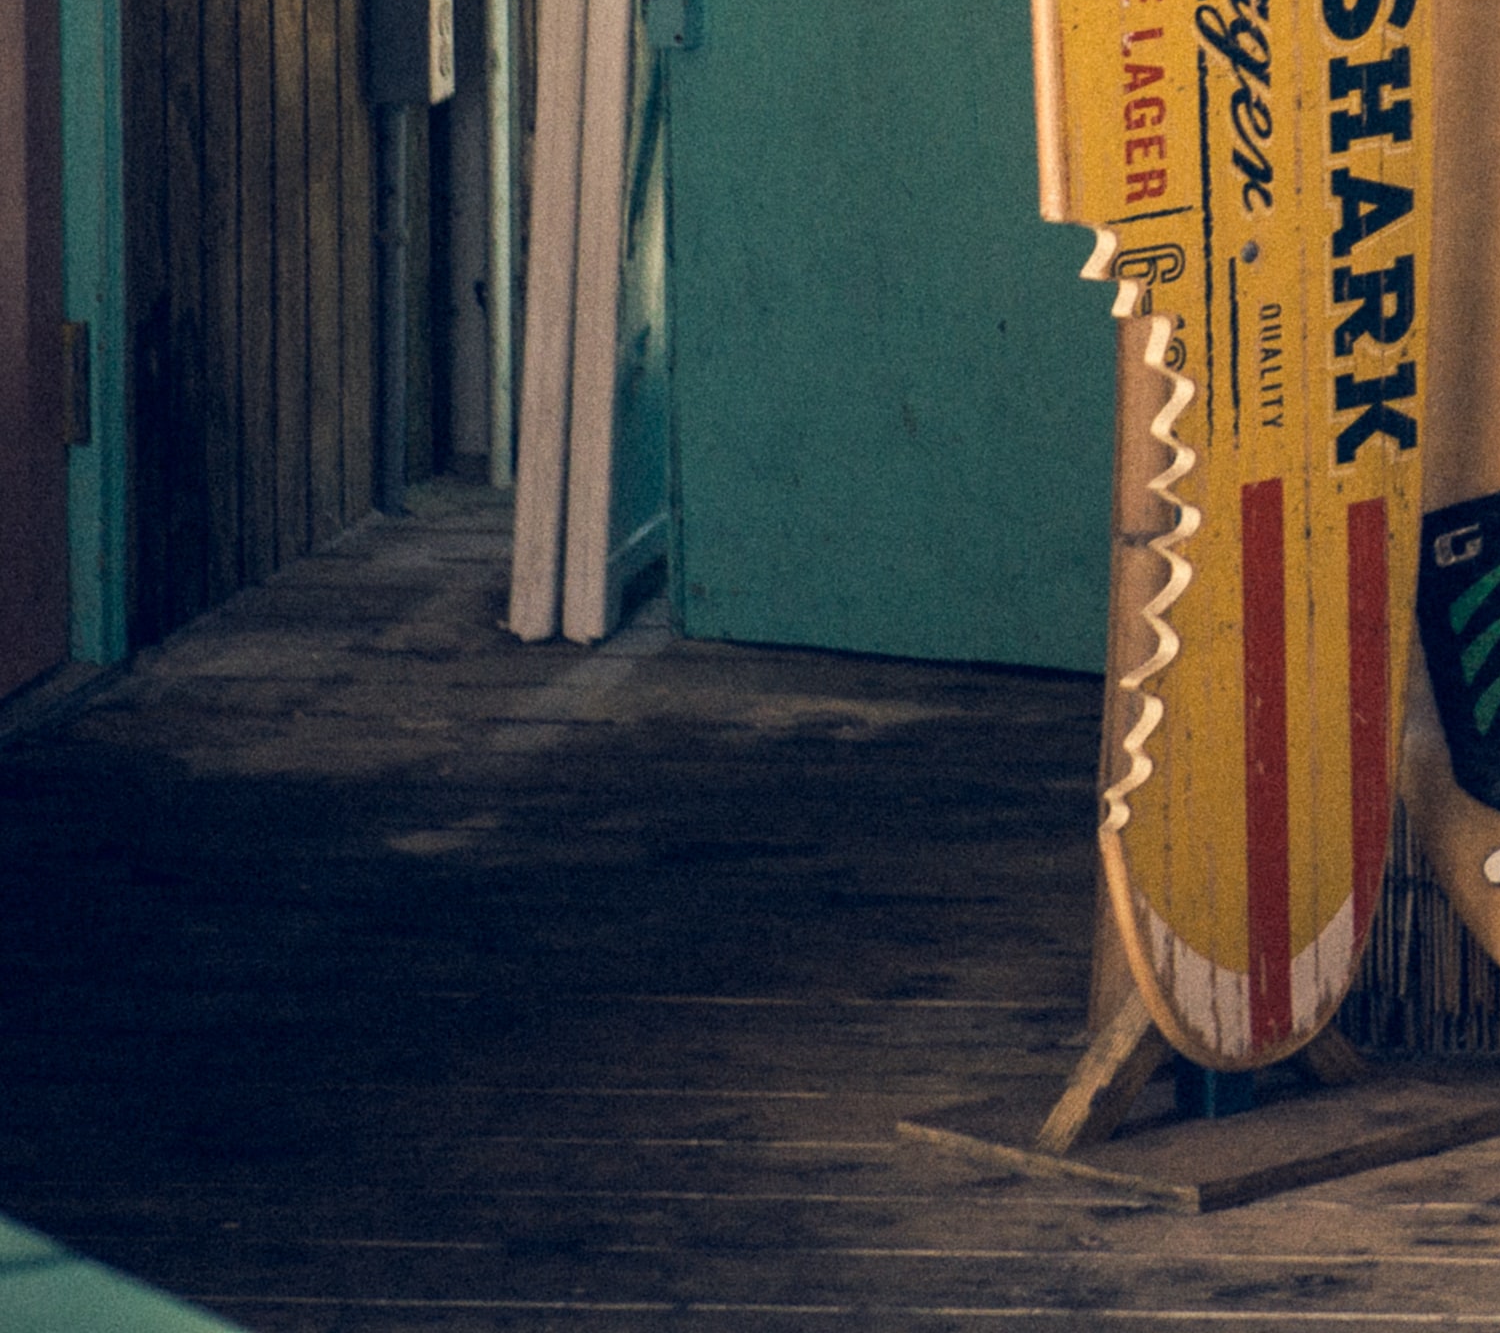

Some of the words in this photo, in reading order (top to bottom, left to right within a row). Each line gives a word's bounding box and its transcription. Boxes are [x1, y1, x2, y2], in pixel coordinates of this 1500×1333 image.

[1120, 28, 1168, 206] LAGER
[1111, 242, 1188, 373] 6-
[1259, 302, 1283, 429] QUALITY
